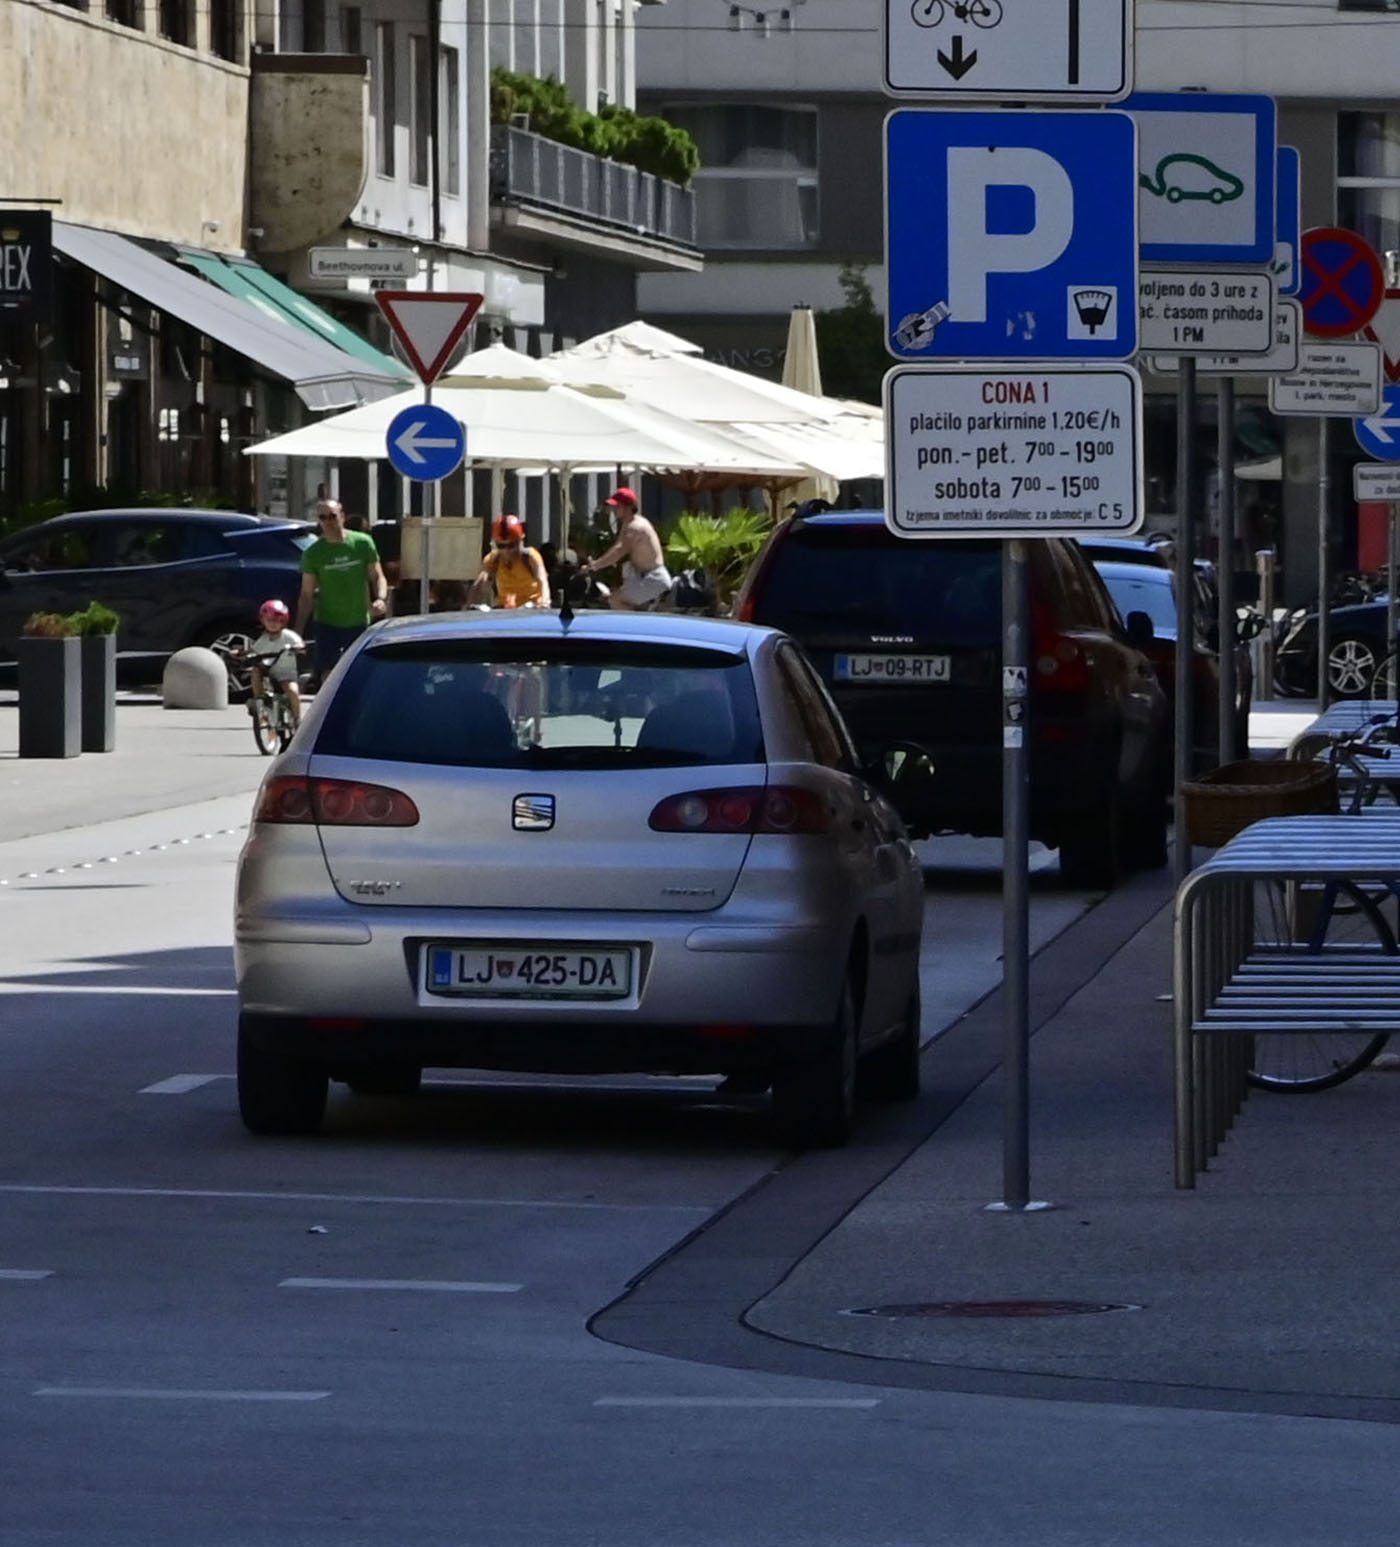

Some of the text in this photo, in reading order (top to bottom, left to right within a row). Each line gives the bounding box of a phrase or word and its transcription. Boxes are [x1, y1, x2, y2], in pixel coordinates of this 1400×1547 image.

[947, 146, 1074, 323] P
[1190, 282, 1206, 296] do
[1211, 282, 1219, 297] 3
[1224, 286, 1246, 297] ure
[1251, 287, 1258, 298] z
[1164, 304, 1208, 320] časom
[1213, 305, 1263, 323] prihoda
[1183, 327, 1204, 342] PM
[982, 381, 1049, 404] CONA 1
[910, 411, 962, 435] plačilo
[967, 411, 1046, 435] parkirnine
[977, 443, 1016, 470] pet.
[935, 478, 1001, 499] sobota
[1099, 503, 1108, 520] C
[1113, 503, 1123, 520] 5
[851, 659, 873, 676] LJ
[458, 954, 617, 986] LJ 425-DA
